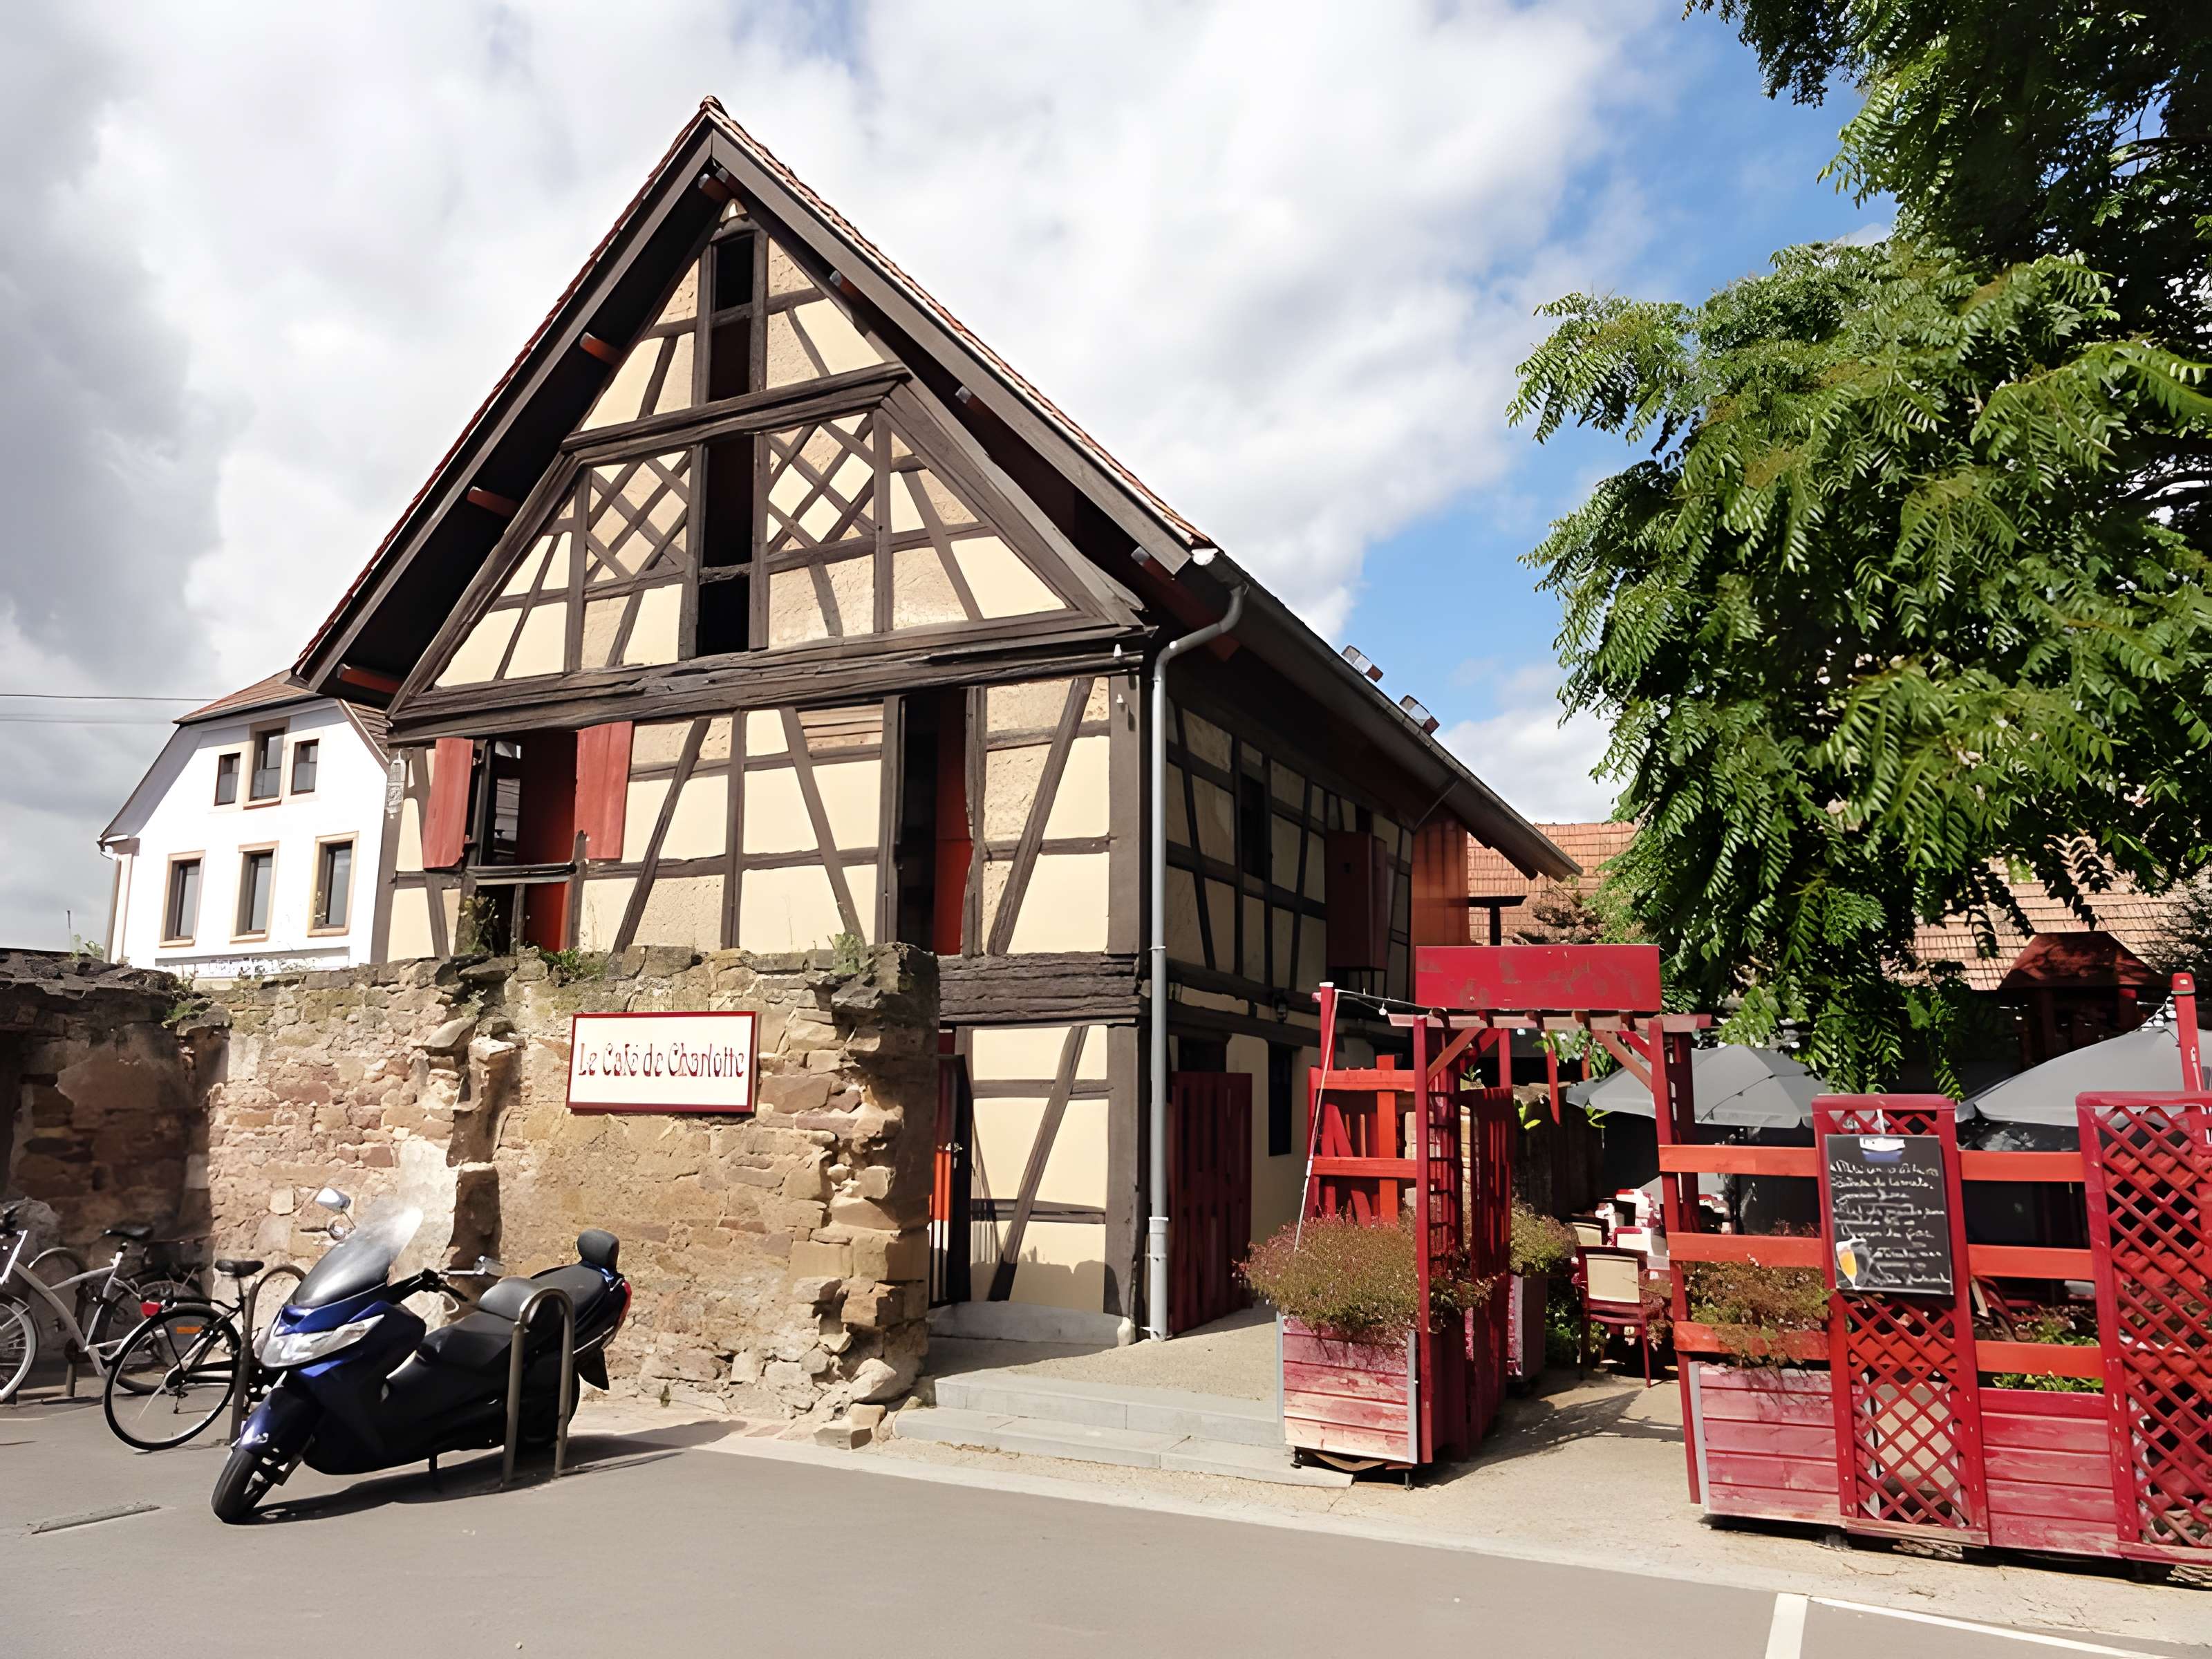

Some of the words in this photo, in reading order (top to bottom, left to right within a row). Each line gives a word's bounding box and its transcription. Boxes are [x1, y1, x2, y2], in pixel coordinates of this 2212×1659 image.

[578, 1042, 597, 1076] Le
[602, 1042, 639, 1077] Café
[642, 1043, 664, 1078] de
[668, 1042, 744, 1078] Charlotte
